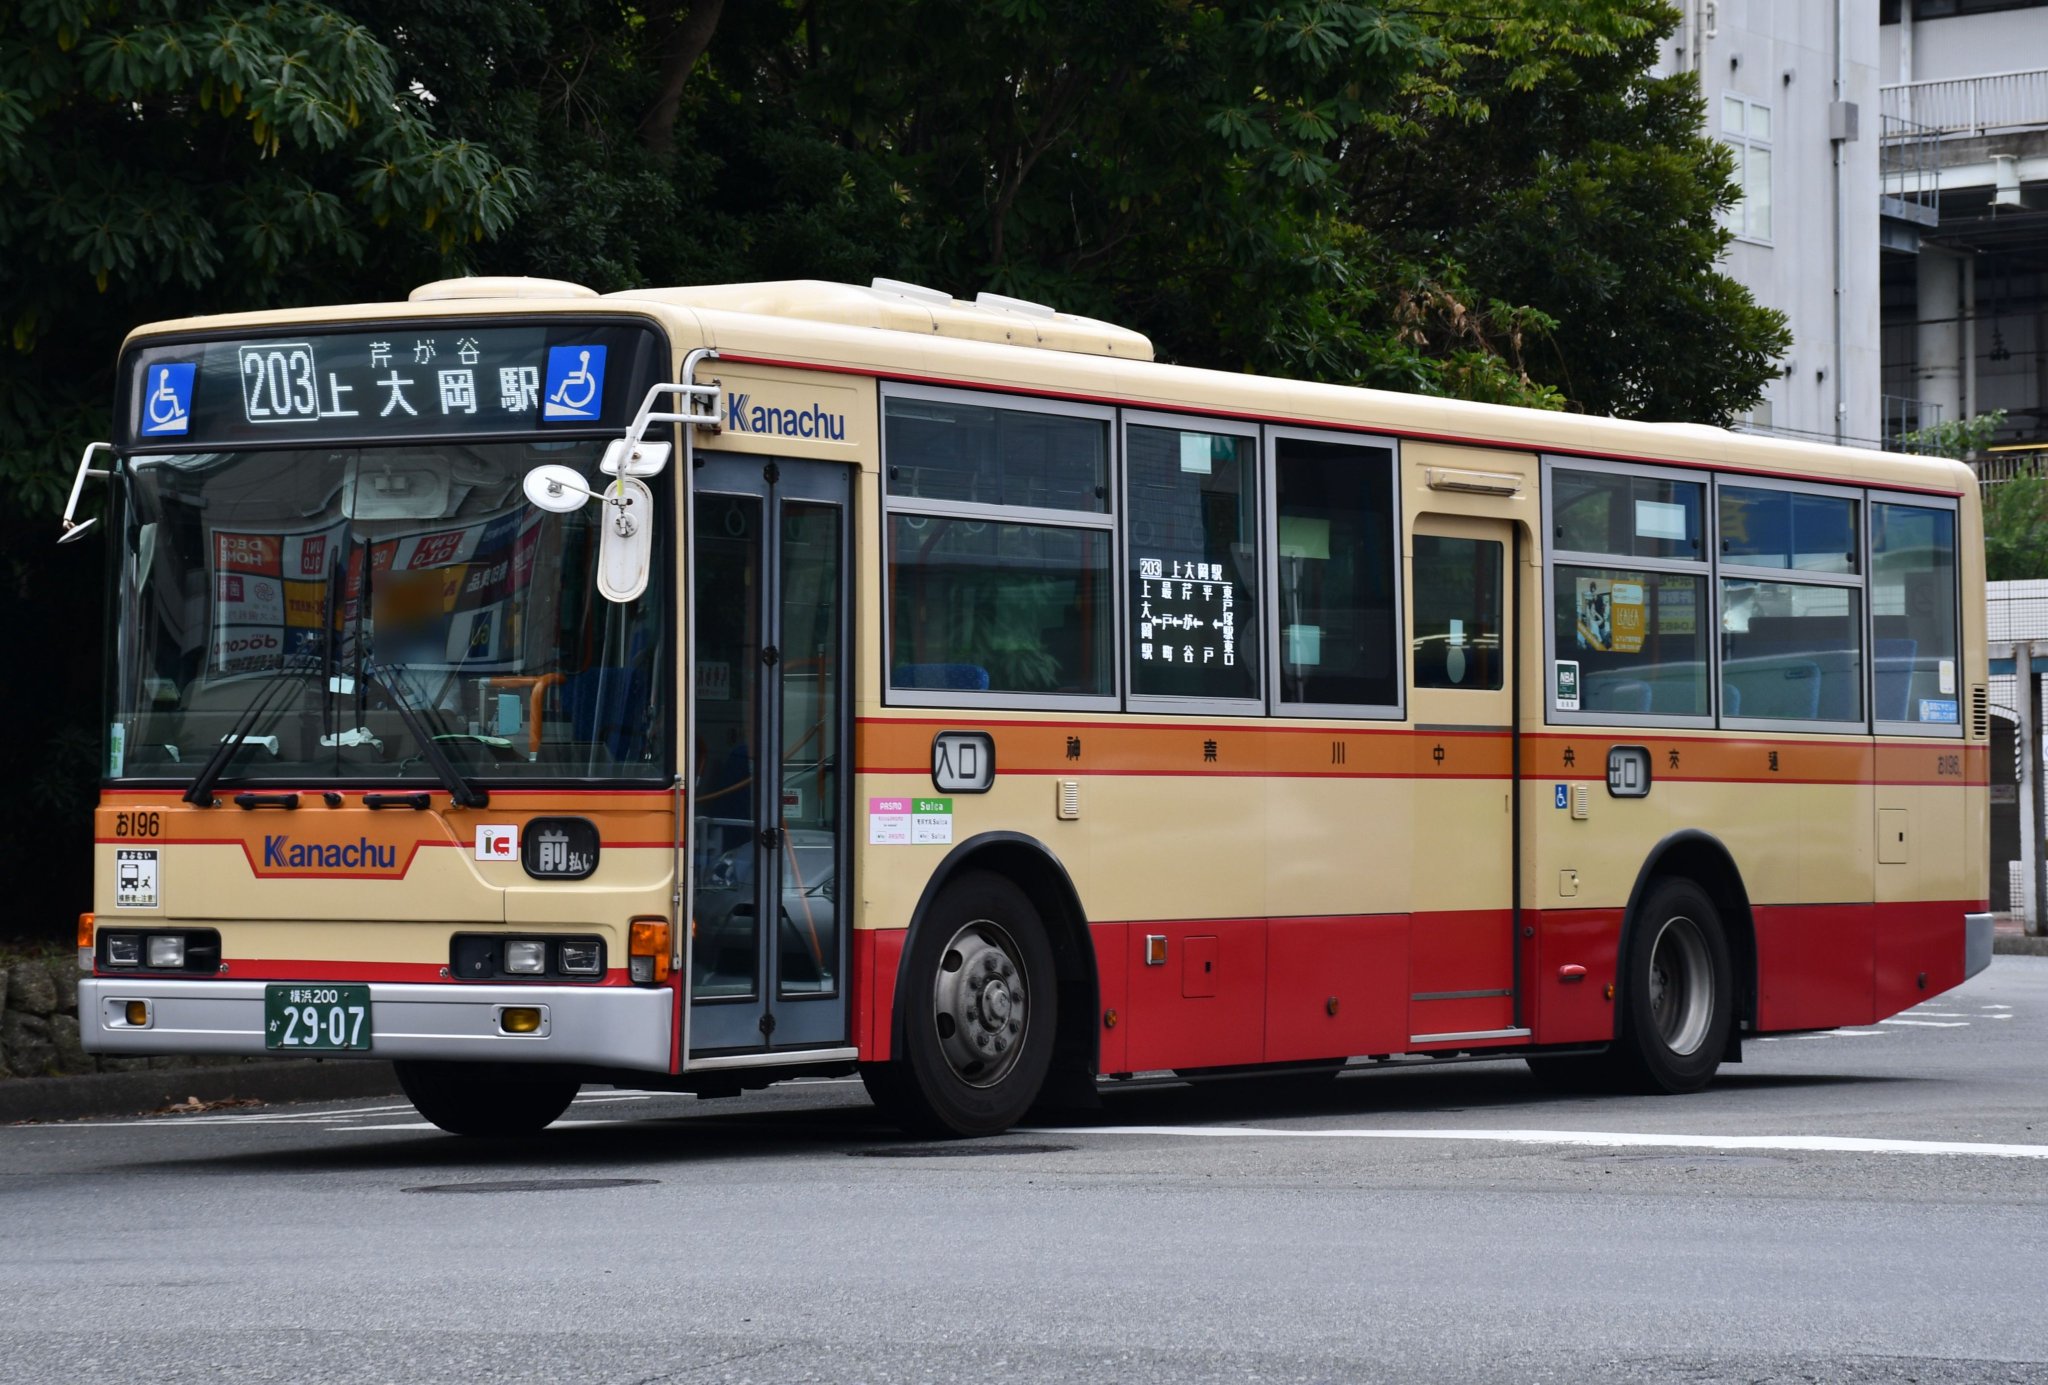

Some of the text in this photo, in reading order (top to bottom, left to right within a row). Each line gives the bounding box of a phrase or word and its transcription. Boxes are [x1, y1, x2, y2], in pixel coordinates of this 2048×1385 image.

[369, 337, 480, 368] 芹が谷
[244, 351, 315, 416] 203
[320, 366, 540, 417] 上大岡駅
[728, 392, 845, 440] Kanachu
[1141, 560, 1160, 576] 203
[1171, 560, 1222, 581] 上大岡駅
[1141, 580, 1153, 660] 上大岡駅
[1161, 581, 1173, 662] 最戸町
[1182, 583, 1194, 663] 芹が谷
[1202, 584, 1214, 663] 平戸
[1222, 585, 1234, 666] 東戸塚駅東口
[936, 741, 977, 779] 入口
[115, 811, 160, 837] お196
[879, 801, 944, 812] PASMO Suica
[264, 835, 396, 868] Kanachu
[538, 829, 594, 872] 前払い
[290, 989, 338, 1004] 横浜200
[269, 1006, 365, 1046] か 29-07
